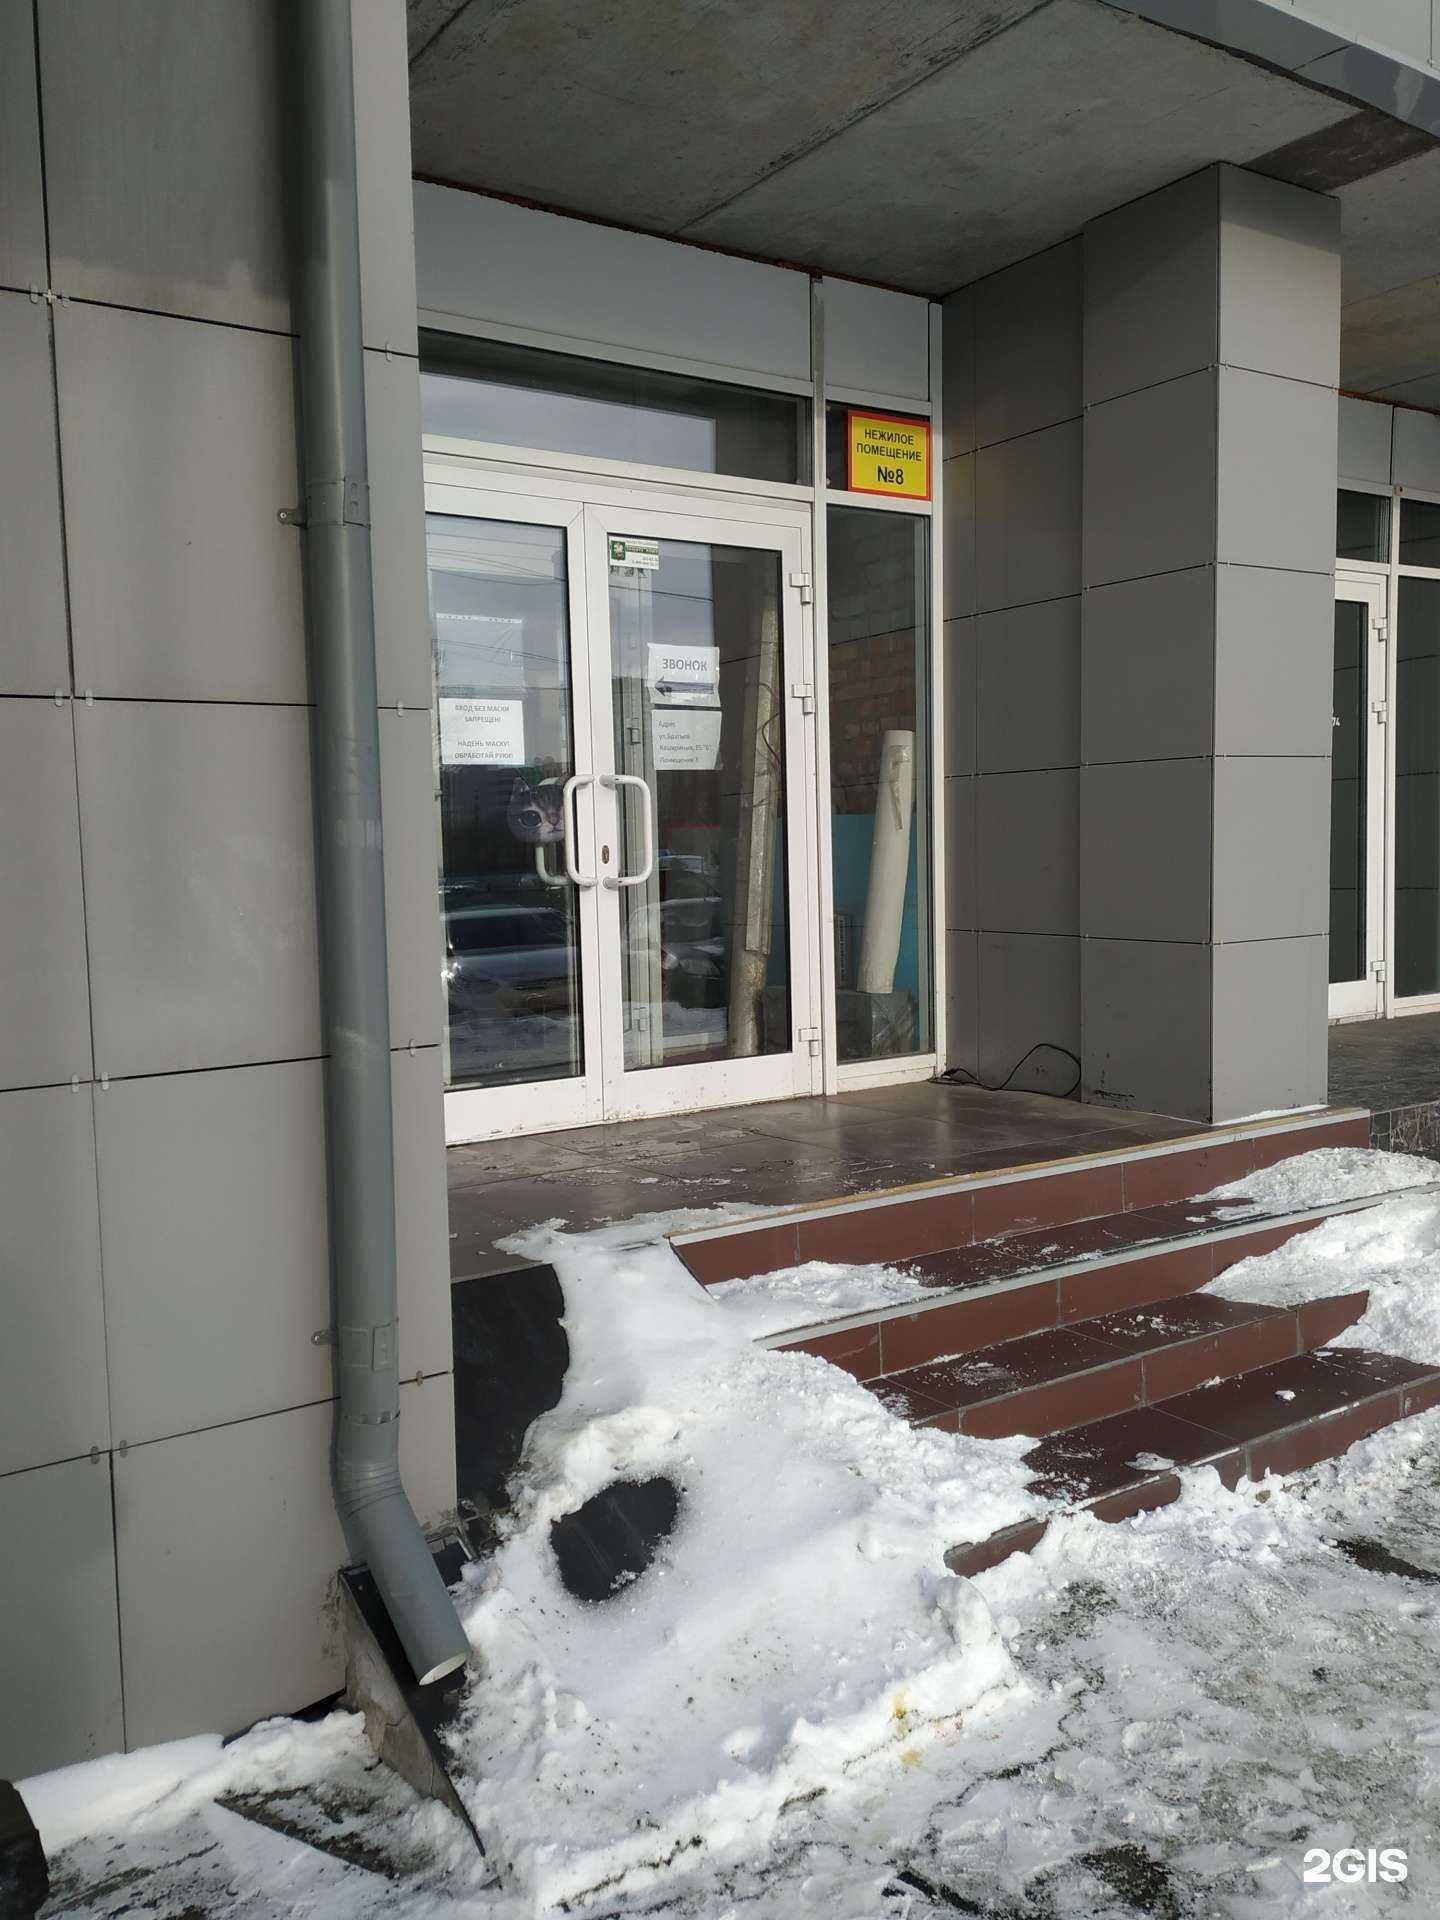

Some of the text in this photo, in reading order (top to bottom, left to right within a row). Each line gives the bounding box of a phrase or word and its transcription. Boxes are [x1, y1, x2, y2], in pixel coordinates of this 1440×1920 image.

[864, 428, 914, 446] НЕЖИЛОЕ
[856, 442, 922, 462] ПОМЕЩЕНИЕ
[877, 465, 904, 485] №8
[662, 659, 708, 671] ЗВОНОК
[458, 740, 484, 748] НАДЕНЬ
